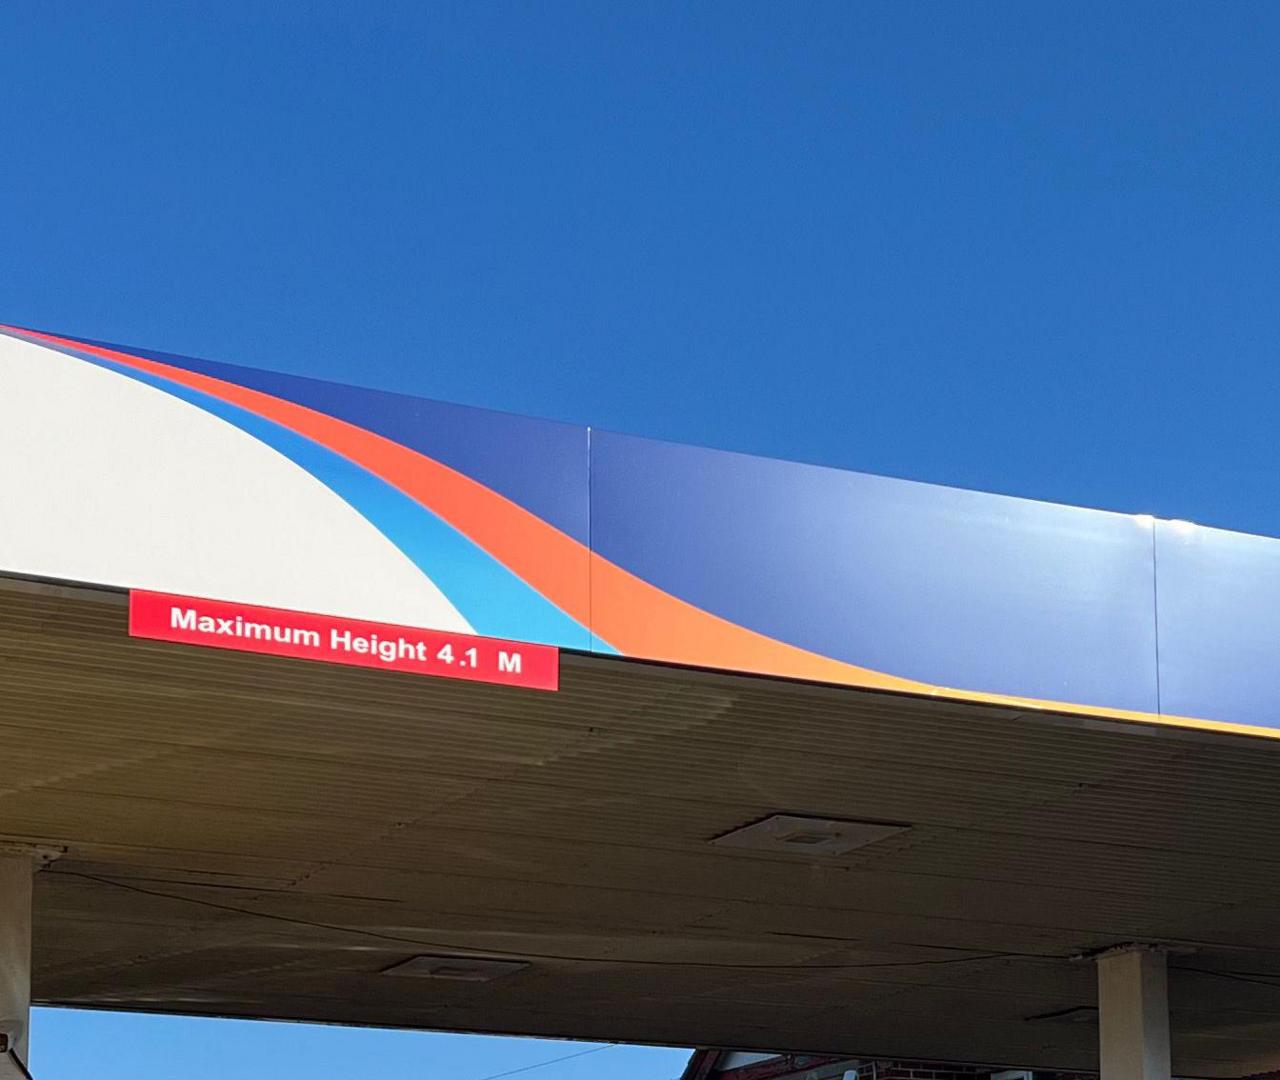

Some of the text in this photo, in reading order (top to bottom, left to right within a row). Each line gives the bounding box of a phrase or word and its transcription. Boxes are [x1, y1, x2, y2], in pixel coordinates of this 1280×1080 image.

[170, 607, 521, 674] Maximum Height 4.1 M
